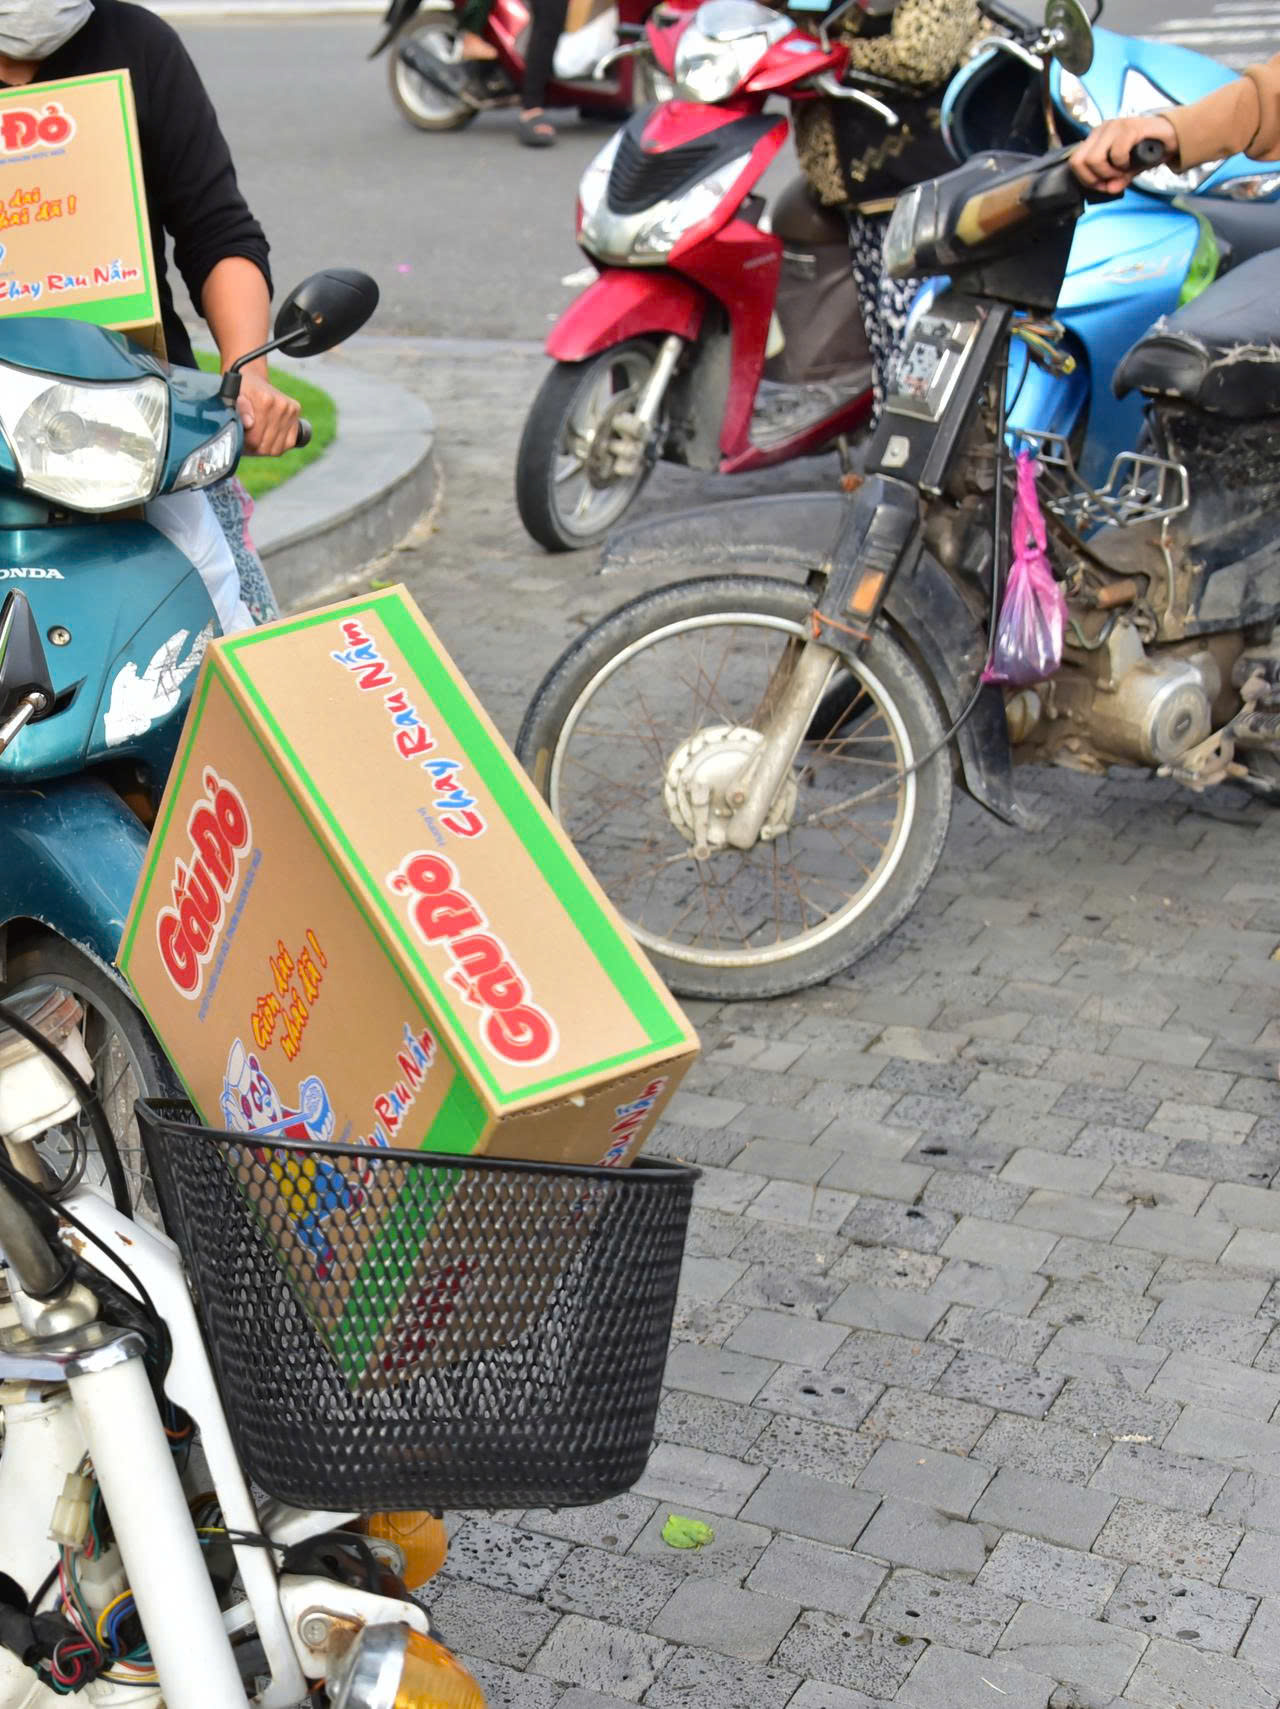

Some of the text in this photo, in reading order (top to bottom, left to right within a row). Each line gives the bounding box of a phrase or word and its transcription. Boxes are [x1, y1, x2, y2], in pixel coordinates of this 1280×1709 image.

[1, 105, 70, 150] Đỏ
[47, 275, 87, 290] Rau
[94, 260, 137, 283] Nấm
[333, 623, 393, 689] Nấm
[387, 692, 434, 758] Rau
[189, 774, 248, 894] Đỏ
[424, 761, 484, 836] Chay
[159, 858, 221, 991] Gấu
[393, 855, 552, 1062] Gấu Đỏ
[280, 987, 308, 1062] nhai
[375, 1085, 412, 1132] Rau
[397, 1024, 433, 1087] Nấm
